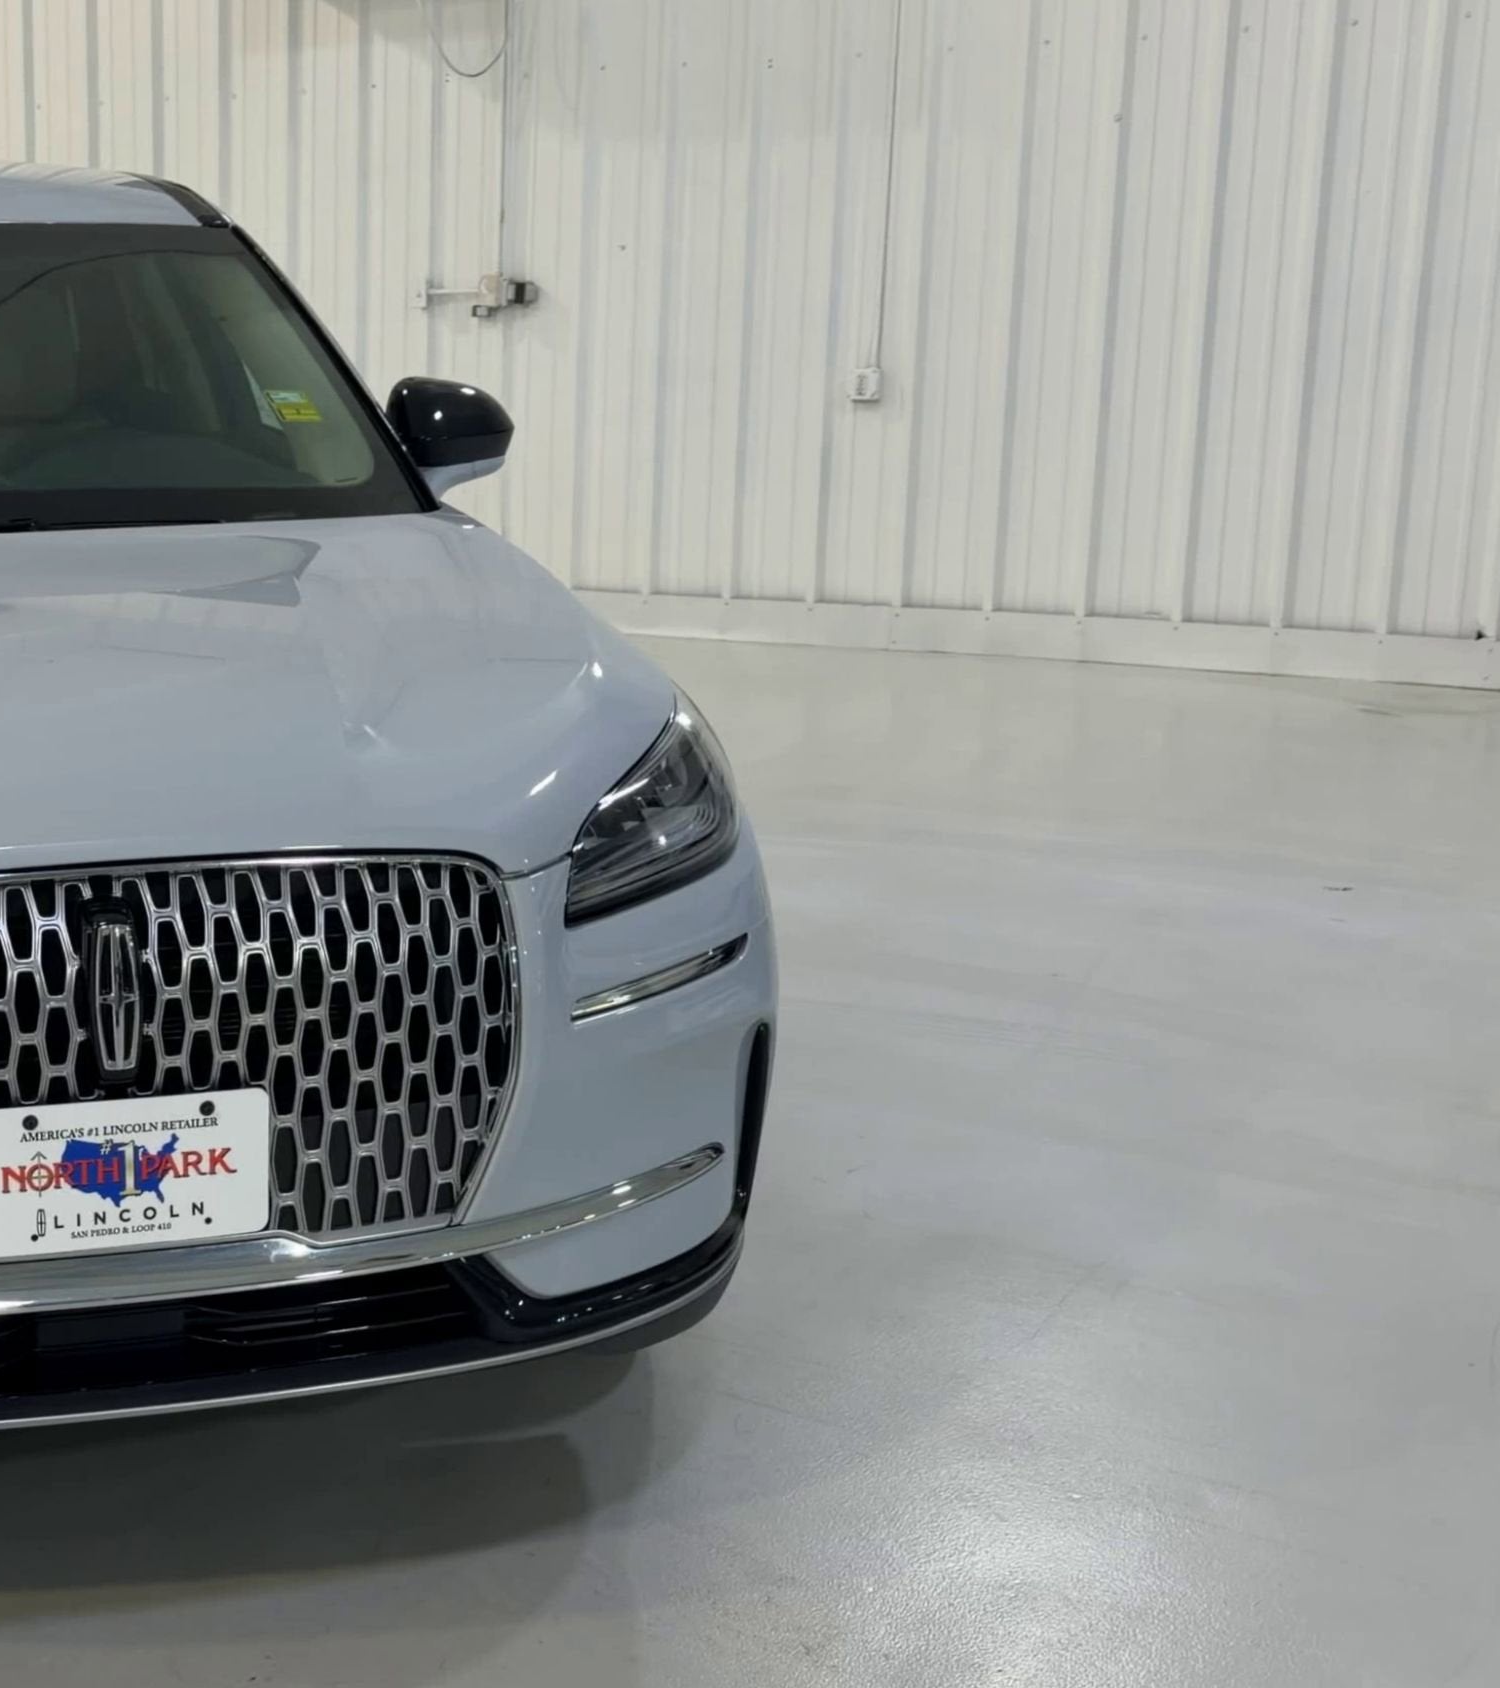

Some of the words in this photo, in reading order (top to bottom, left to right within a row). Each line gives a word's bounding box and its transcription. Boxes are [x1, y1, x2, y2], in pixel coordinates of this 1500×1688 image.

[20, 1128, 84, 1143] AMERICA'S
[87, 1127, 99, 1137] #1
[103, 1122, 158, 1136] LINCOLN
[161, 1117, 219, 1131] RETAILER
[1, 1157, 120, 1194] NORTH
[141, 1147, 237, 1179] PARK
[53, 1201, 204, 1229] LINCOLN
[71, 1230, 88, 1239] SAN
[90, 1227, 120, 1237] PEDRO
[122, 1226, 129, 1234] &
[131, 1223, 155, 1233] LOOP
[157, 1222, 172, 1231] 410
